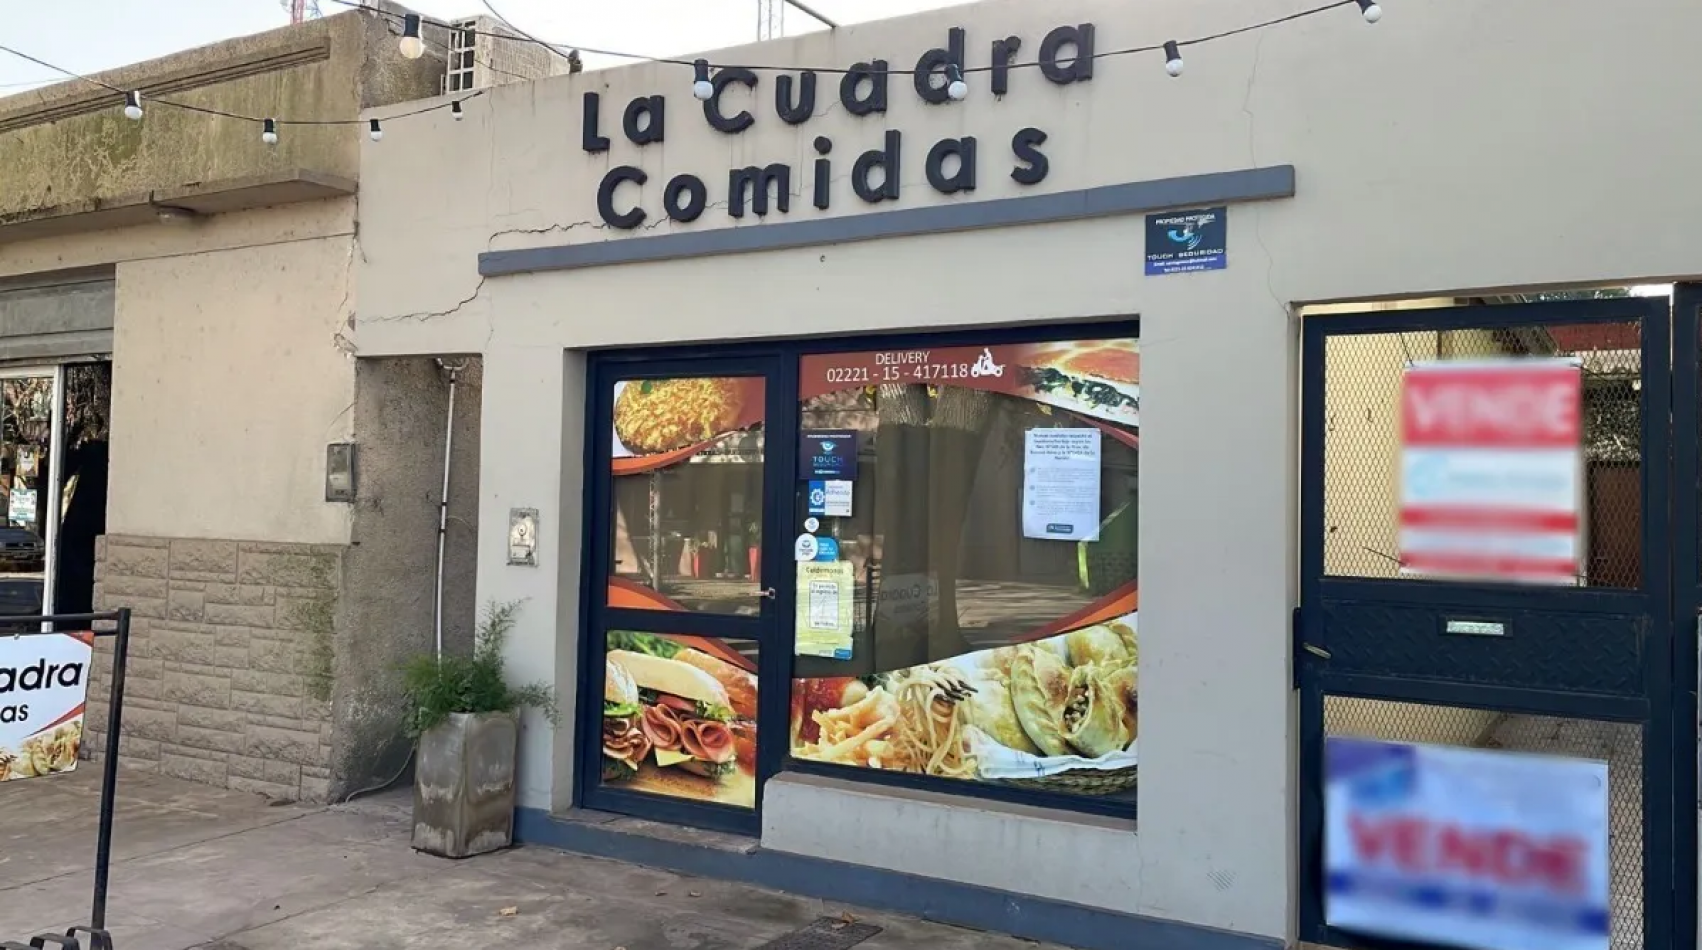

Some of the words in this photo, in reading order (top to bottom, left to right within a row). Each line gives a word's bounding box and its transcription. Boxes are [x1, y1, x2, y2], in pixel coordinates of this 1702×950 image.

[582, 91, 665, 153] La
[703, 22, 1096, 134] Cuadra
[597, 127, 1050, 230] Comidas
[826, 367, 869, 382] 02221
[882, 366, 900, 381] 15
[913, 363, 968, 379] 417118
[875, 351, 930, 365] DELIVERY
